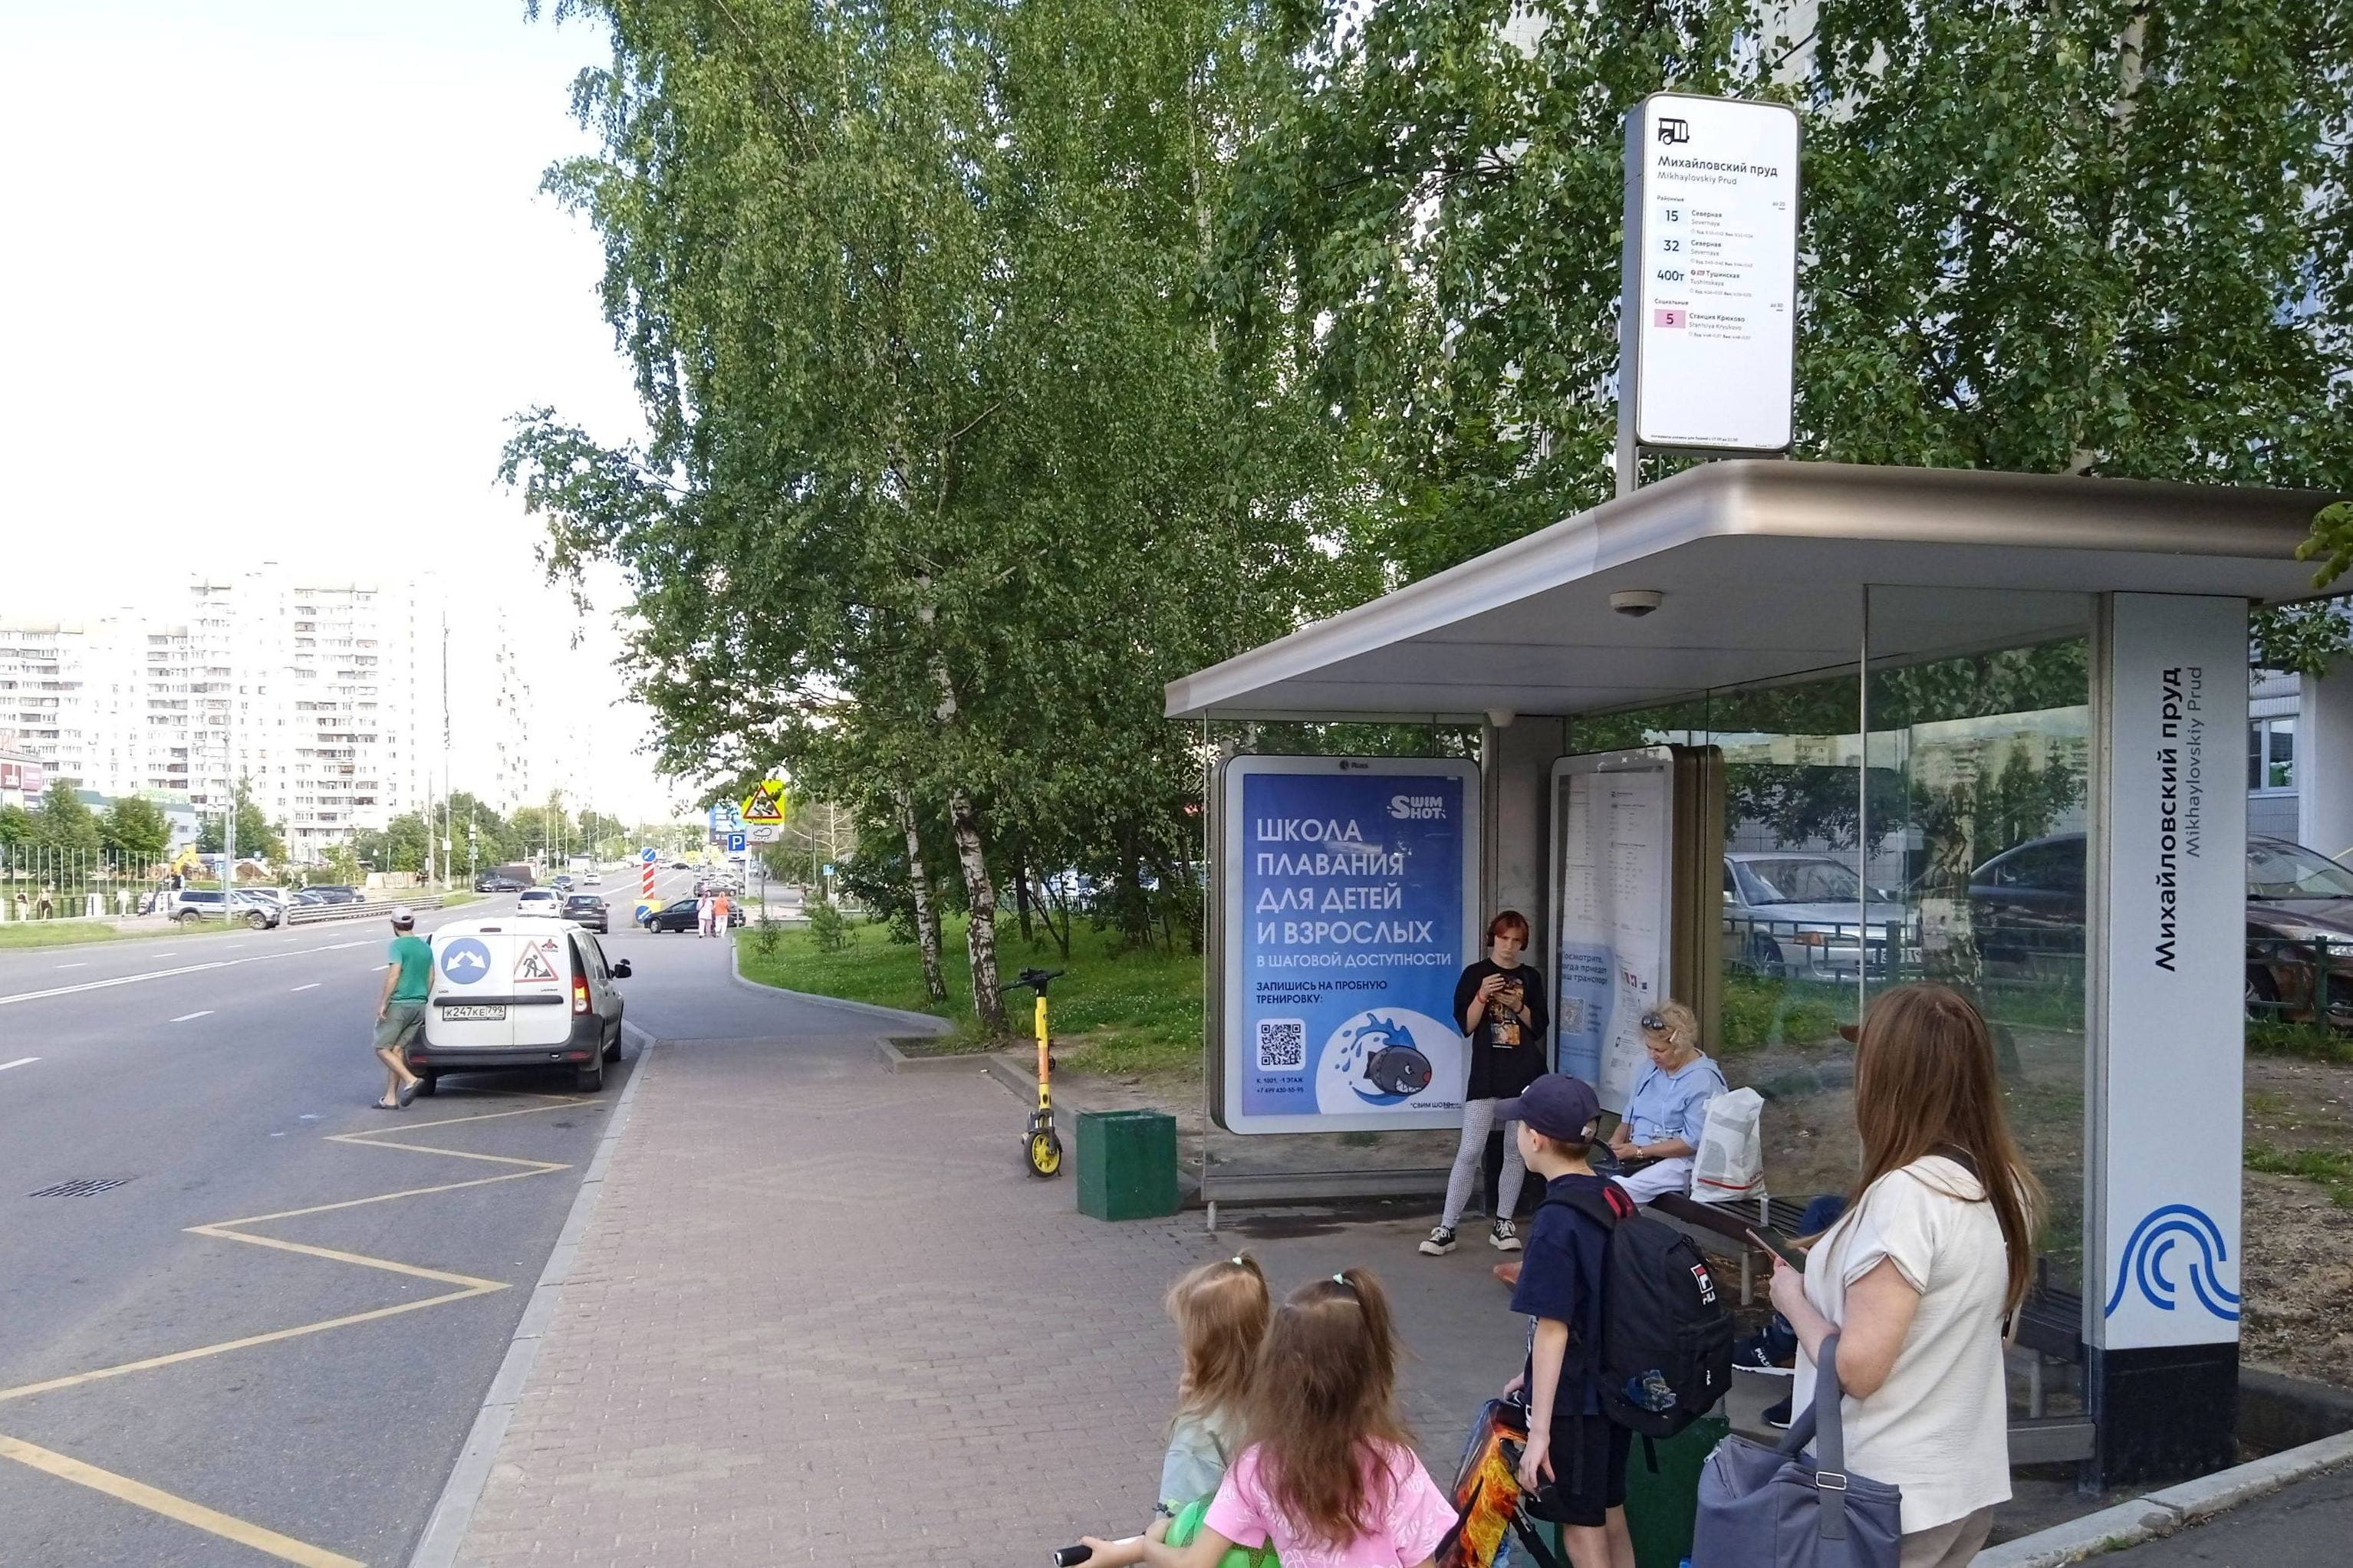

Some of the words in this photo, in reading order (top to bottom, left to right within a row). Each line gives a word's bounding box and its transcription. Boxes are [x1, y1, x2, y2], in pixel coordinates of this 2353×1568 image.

[1657, 155, 1747, 173] Михайловский
[1750, 166, 1778, 178] пруд
[1657, 171, 1716, 185] Mikhaylovskiy
[1718, 176, 1738, 185] Prud
[1665, 209, 1679, 222] 15
[1691, 209, 1723, 219] Северная
[1664, 239, 1680, 251] 32
[1690, 239, 1722, 248] Северная
[1706, 270, 1740, 279] Тушинская
[1666, 313, 1674, 324] 5
[1689, 312, 1716, 321] Станция
[1716, 314, 1746, 323] Крюково
[2187, 666, 2202, 712] Prud
[2161, 667, 2183, 738] пруд
[2186, 718, 2204, 858] Mikhaylovskiy
[1257, 819, 1363, 842] ШКОЛА
[732, 836, 742, 850] P
[1257, 853, 1404, 876] ПЛАВАНИЯ
[2155, 748, 2177, 971] Михайловский
[1255, 887, 1314, 913] ДЛЯ
[1321, 882, 1402, 913] ДЕТЕЙ
[1257, 922, 1275, 945] И
[1284, 921, 1433, 945] ВЗРОСЛЫХ
[1257, 955, 1265, 968] В
[1268, 952, 1342, 968] ШАГОВОЙ
[1344, 953, 1451, 968] ДОСТУПНОСТИ
[1256, 981, 1316, 991] ЗАПИШИСЬ
[1318, 981, 1334, 991] НА
[1335, 980, 1387, 991] ПРОБНУЮ
[1256, 994, 1323, 1004] ТРЕНИРОВКУ:
